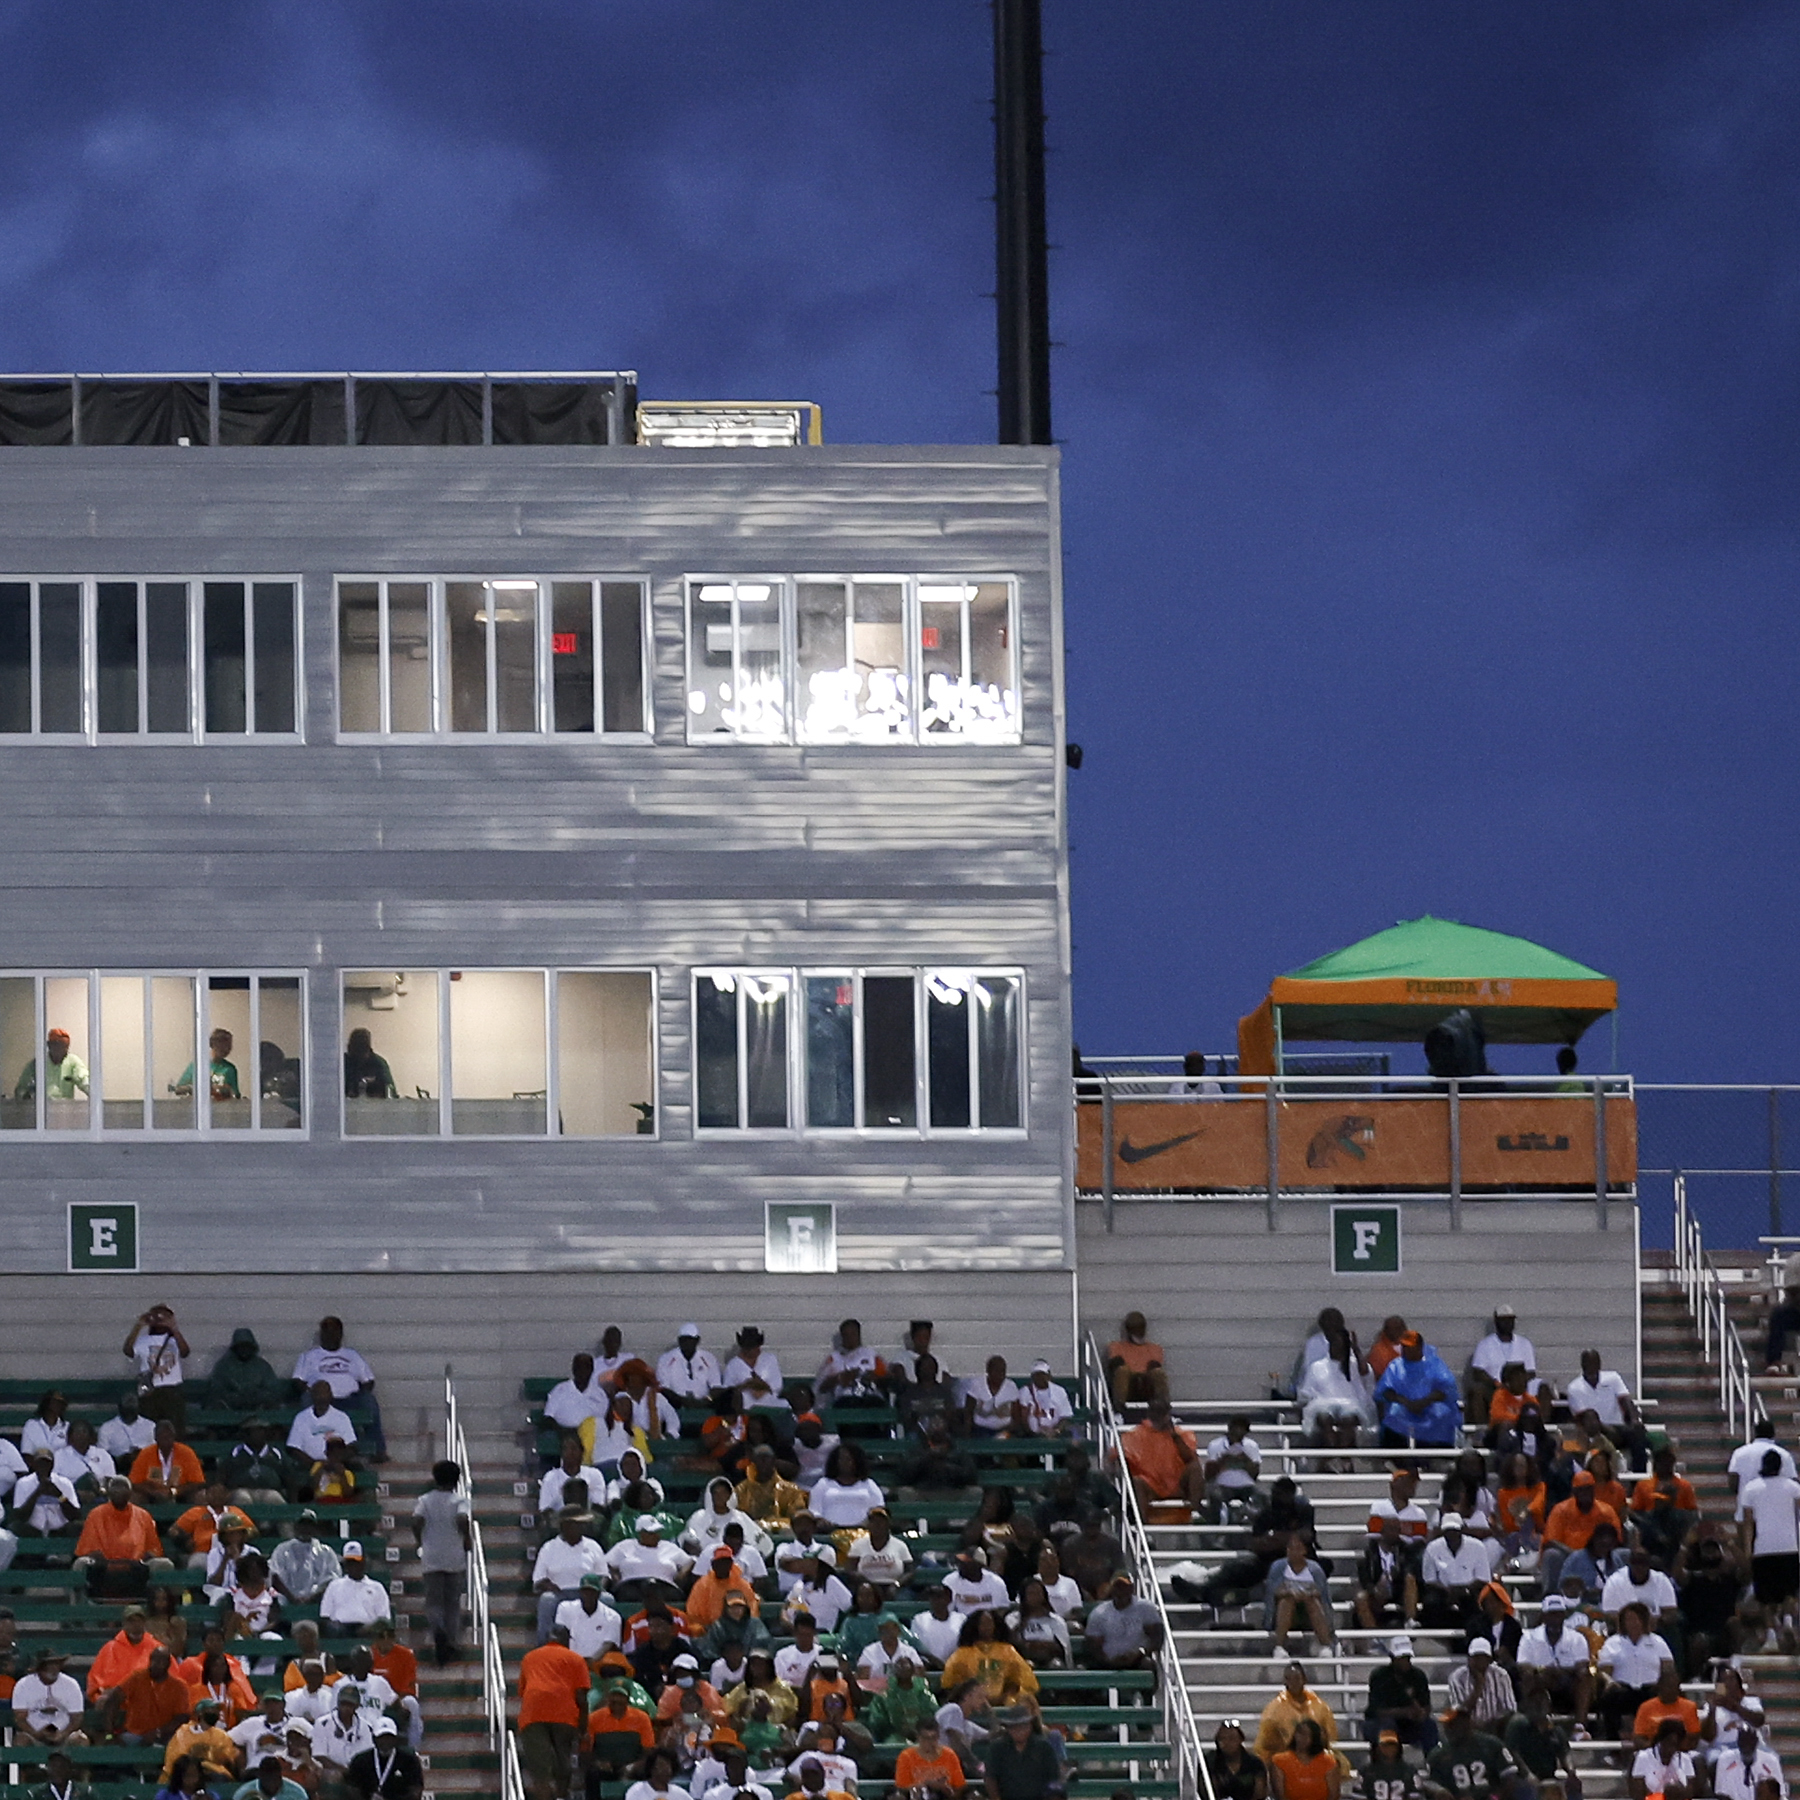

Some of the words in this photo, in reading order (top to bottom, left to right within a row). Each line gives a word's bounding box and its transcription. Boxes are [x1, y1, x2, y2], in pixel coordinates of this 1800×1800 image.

[89, 1218, 118, 1256] E
[1352, 1221, 1381, 1259] F
[1374, 1780, 1404, 1800] 92
[1452, 1760, 1489, 1788] 92
